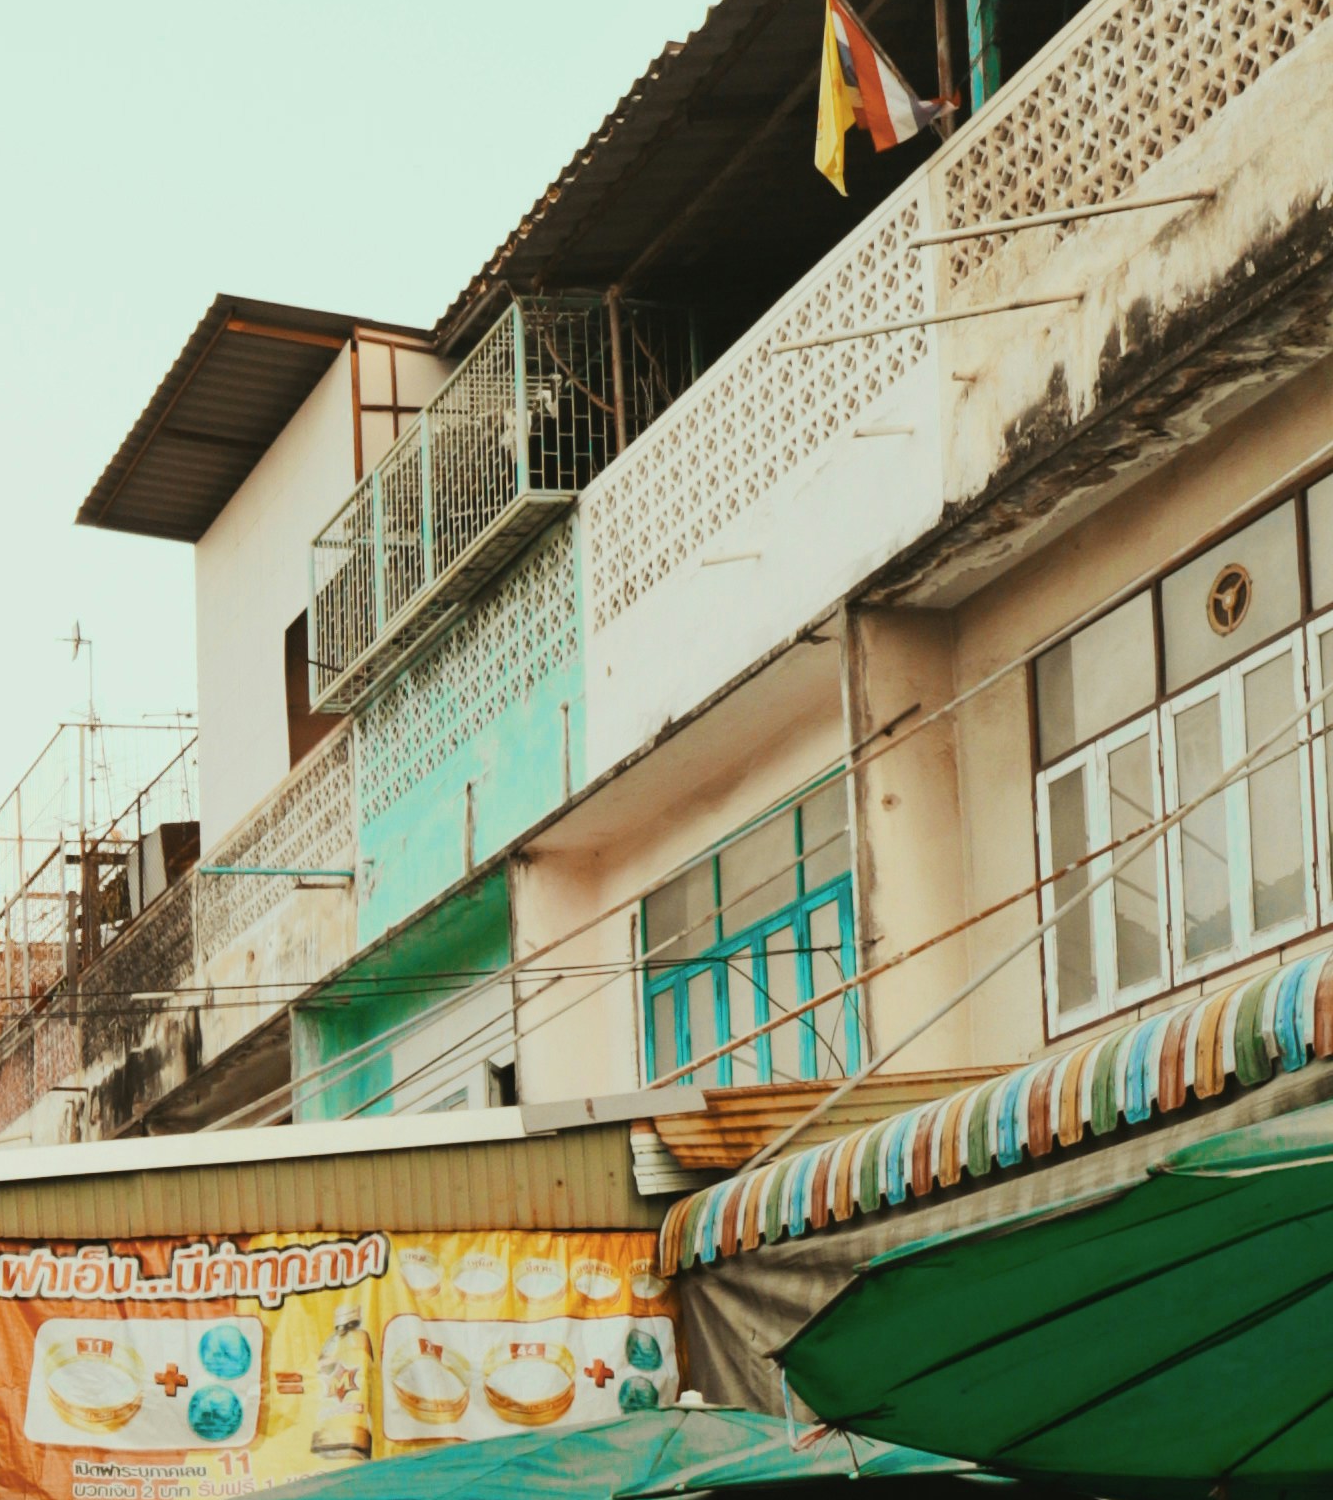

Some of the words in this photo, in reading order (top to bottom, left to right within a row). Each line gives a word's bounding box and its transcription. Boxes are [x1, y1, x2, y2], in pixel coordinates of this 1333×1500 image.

[85, 1339, 104, 1354] 11
[218, 1452, 250, 1475] 11
[74, 1481, 135, 1498] บวกเงิน
[141, 1484, 154, 1498] 2
[160, 1484, 190, 1498] บาท
[198, 1478, 255, 1497] รับฟรี
